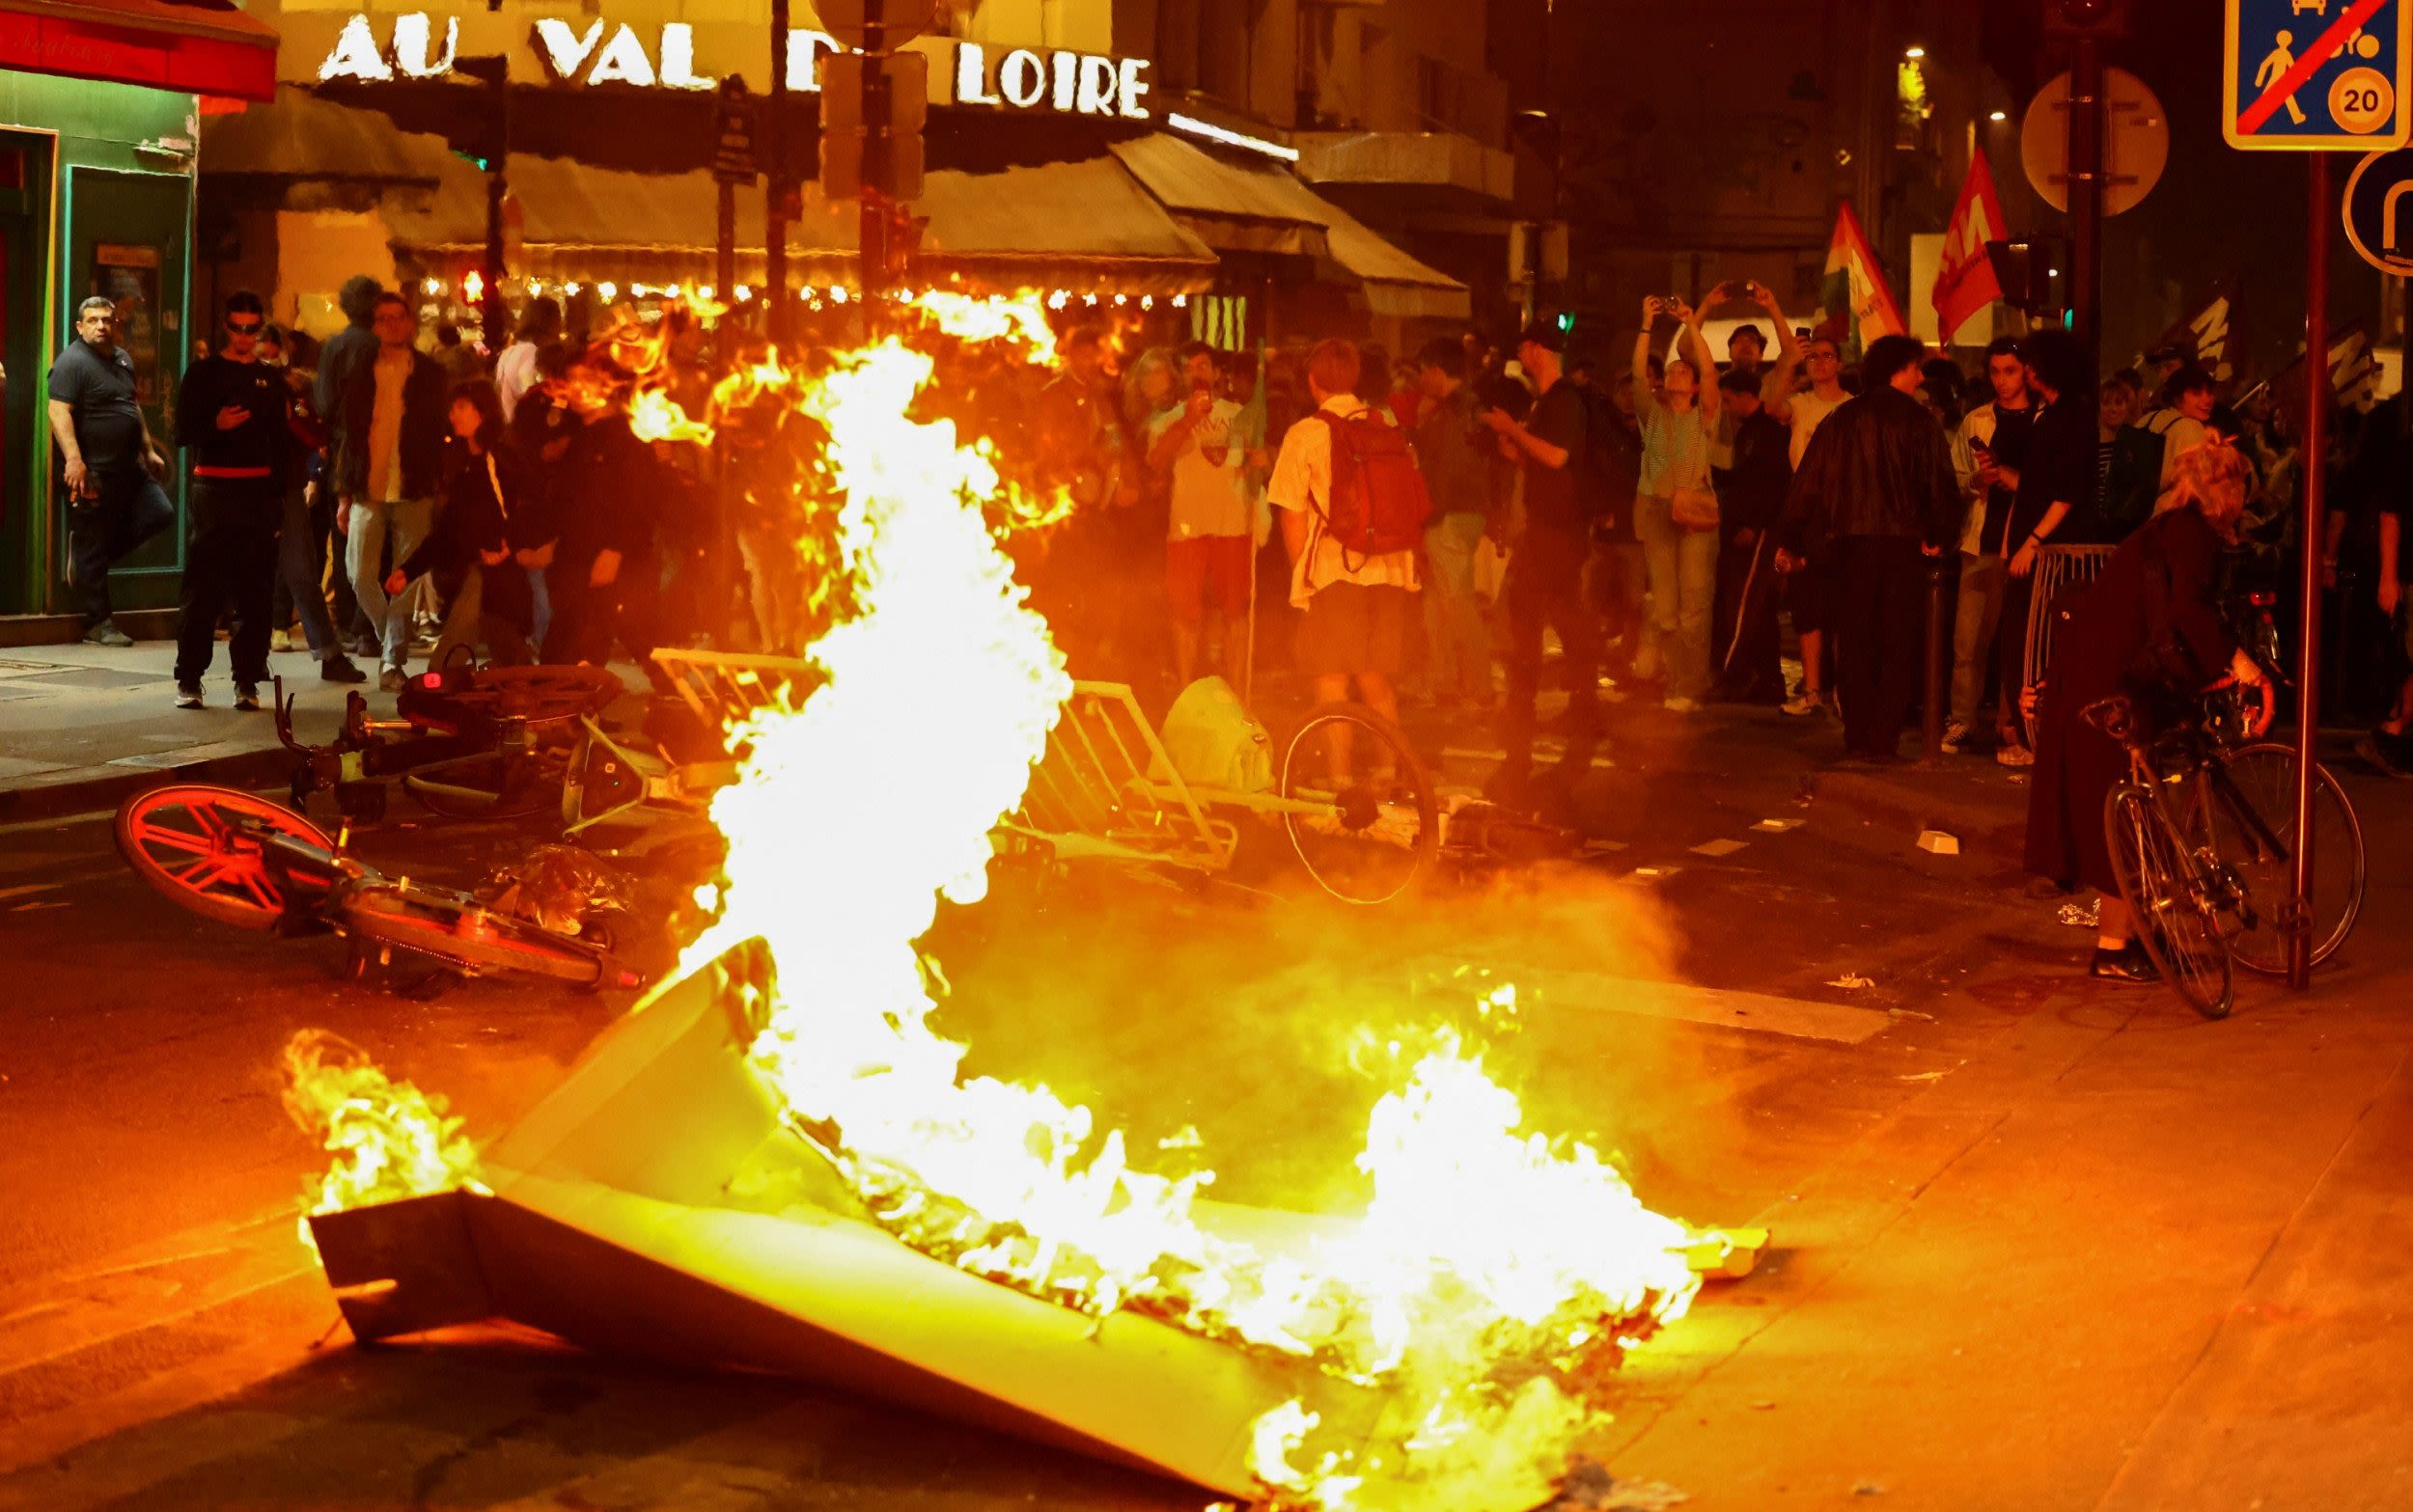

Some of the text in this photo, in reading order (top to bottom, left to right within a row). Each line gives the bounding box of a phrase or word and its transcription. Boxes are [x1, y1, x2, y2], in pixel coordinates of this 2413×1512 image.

[317, 12, 1150, 119] AU VAL D LOIRE
[2344, 89, 2378, 112] 20
